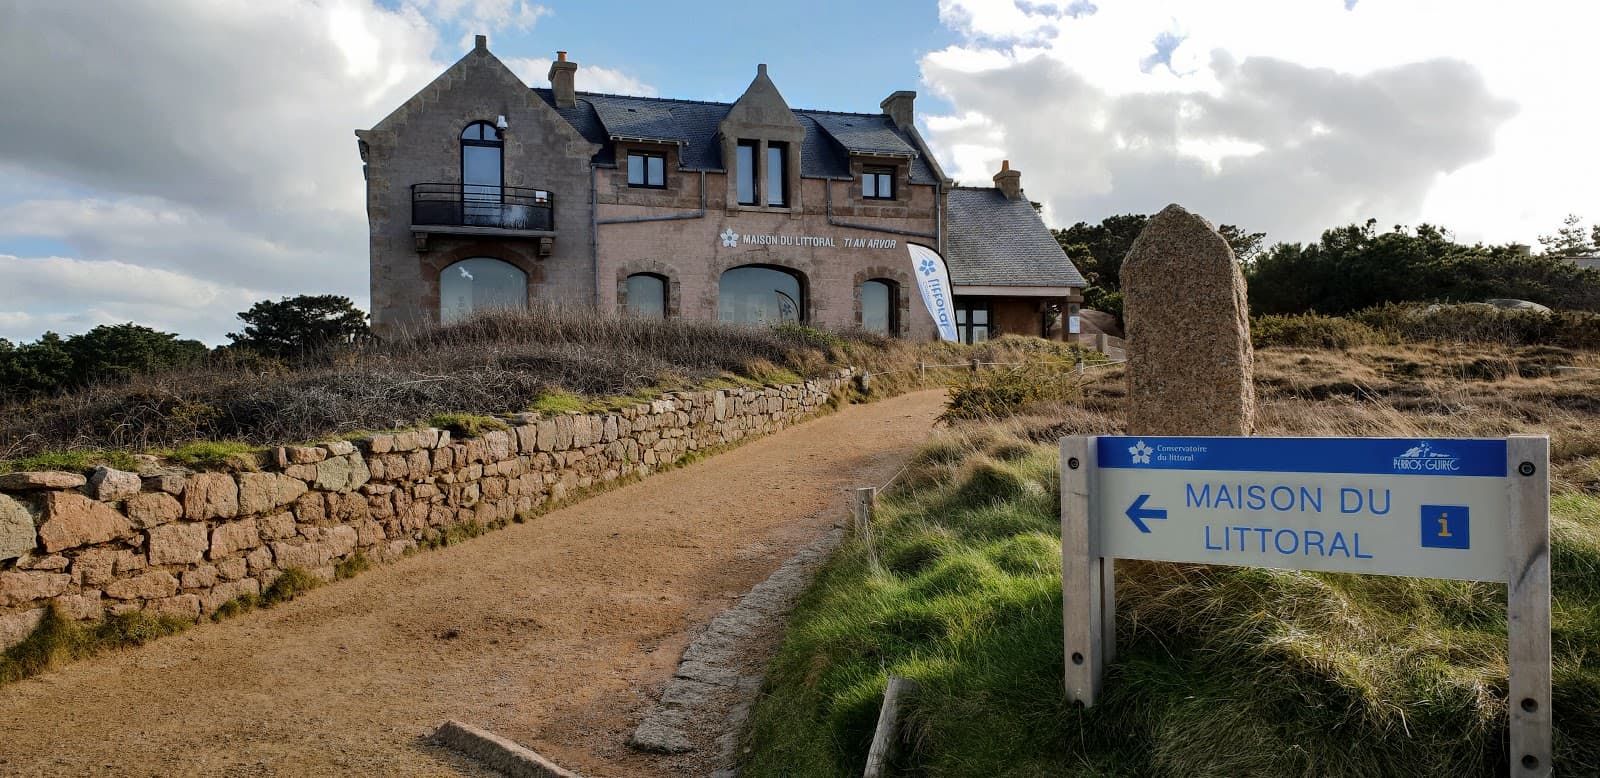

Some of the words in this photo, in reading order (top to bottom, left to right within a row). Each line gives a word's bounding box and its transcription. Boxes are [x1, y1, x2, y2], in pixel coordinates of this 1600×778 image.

[743, 234, 778, 245] MAISON
[780, 236, 793, 246] DU
[795, 236, 836, 247] LITTORAL
[844, 238, 852, 247] TI
[853, 238, 866, 248] AN
[867, 239, 897, 249] ARVOR
[1157, 444, 1208, 453] Conservatoire
[1157, 453, 1167, 461] du
[1169, 454, 1194, 462] littoral
[1186, 483, 1323, 513] MAISON
[1340, 488, 1391, 515] DU
[1205, 525, 1373, 559] LITTORAL
